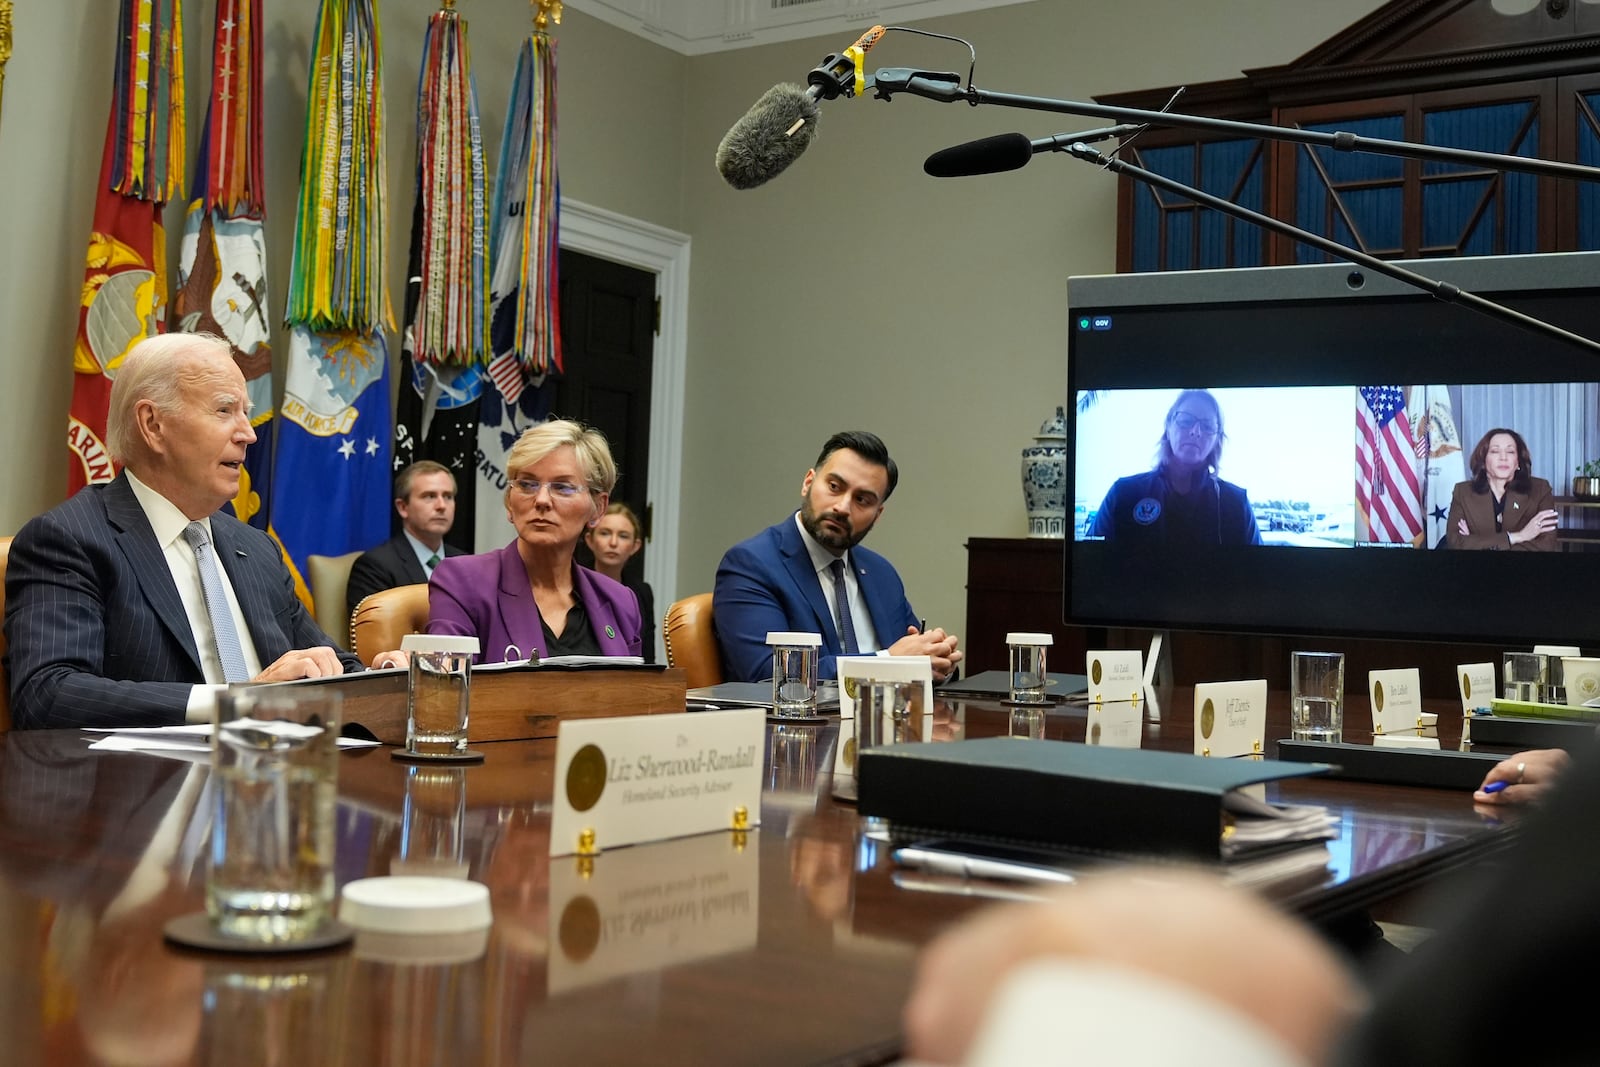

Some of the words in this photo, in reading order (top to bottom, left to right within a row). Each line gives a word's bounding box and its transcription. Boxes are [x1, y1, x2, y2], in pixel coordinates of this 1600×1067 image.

[342, 32, 354, 74] QUEMOY
[342, 80, 354, 101] AND
[342, 106, 353, 140] MATSU
[470, 116, 484, 179] LEBANON
[338, 145, 351, 190] ISLANDS
[608, 758, 633, 783] Liz
[635, 746, 756, 780] Sherwood-Randall
